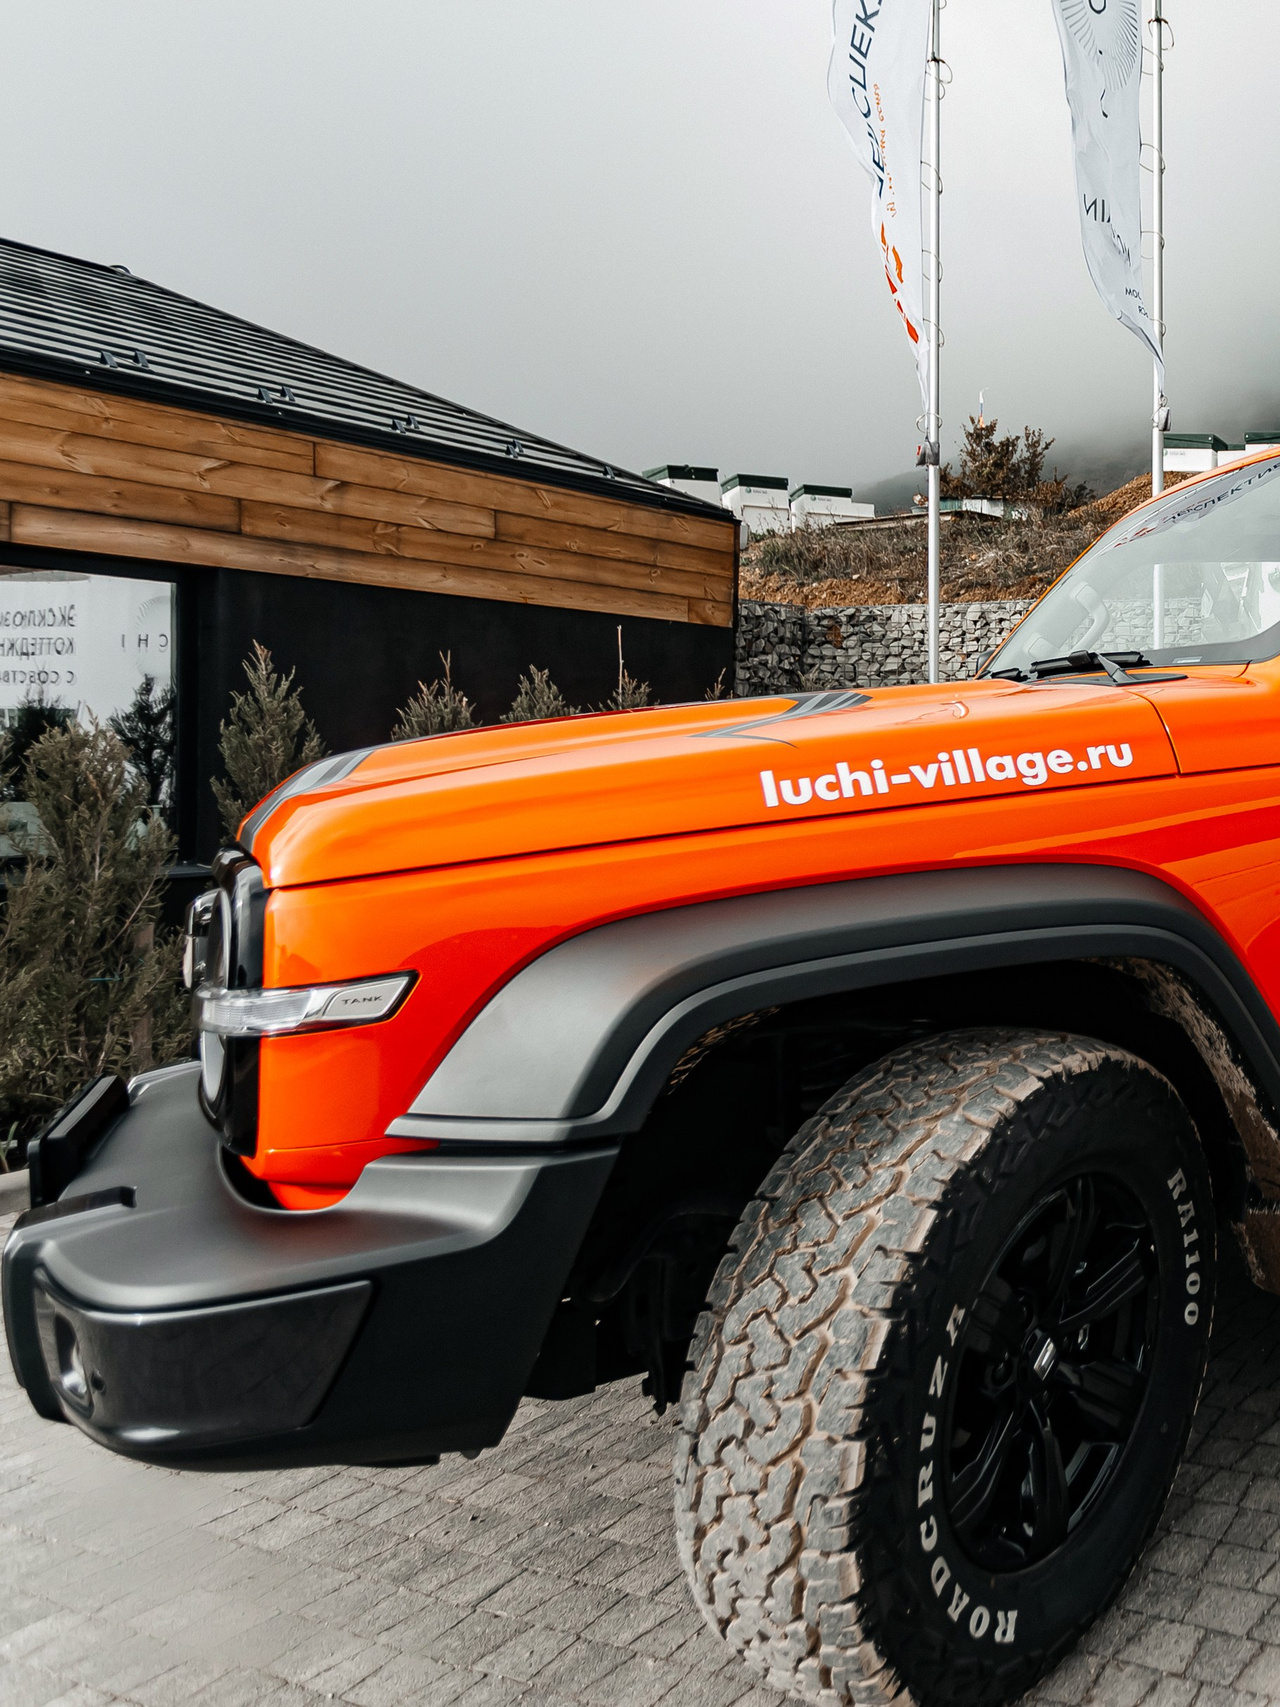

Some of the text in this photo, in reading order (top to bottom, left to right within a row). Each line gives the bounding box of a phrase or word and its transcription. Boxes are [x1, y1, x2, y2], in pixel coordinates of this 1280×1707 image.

[759, 743, 1134, 808] luchi-village.ru
[341, 995, 382, 1005] TANK
[1166, 1167, 1201, 1326] RA1100
[917, 1303, 1018, 1644] ROADCRUZA
